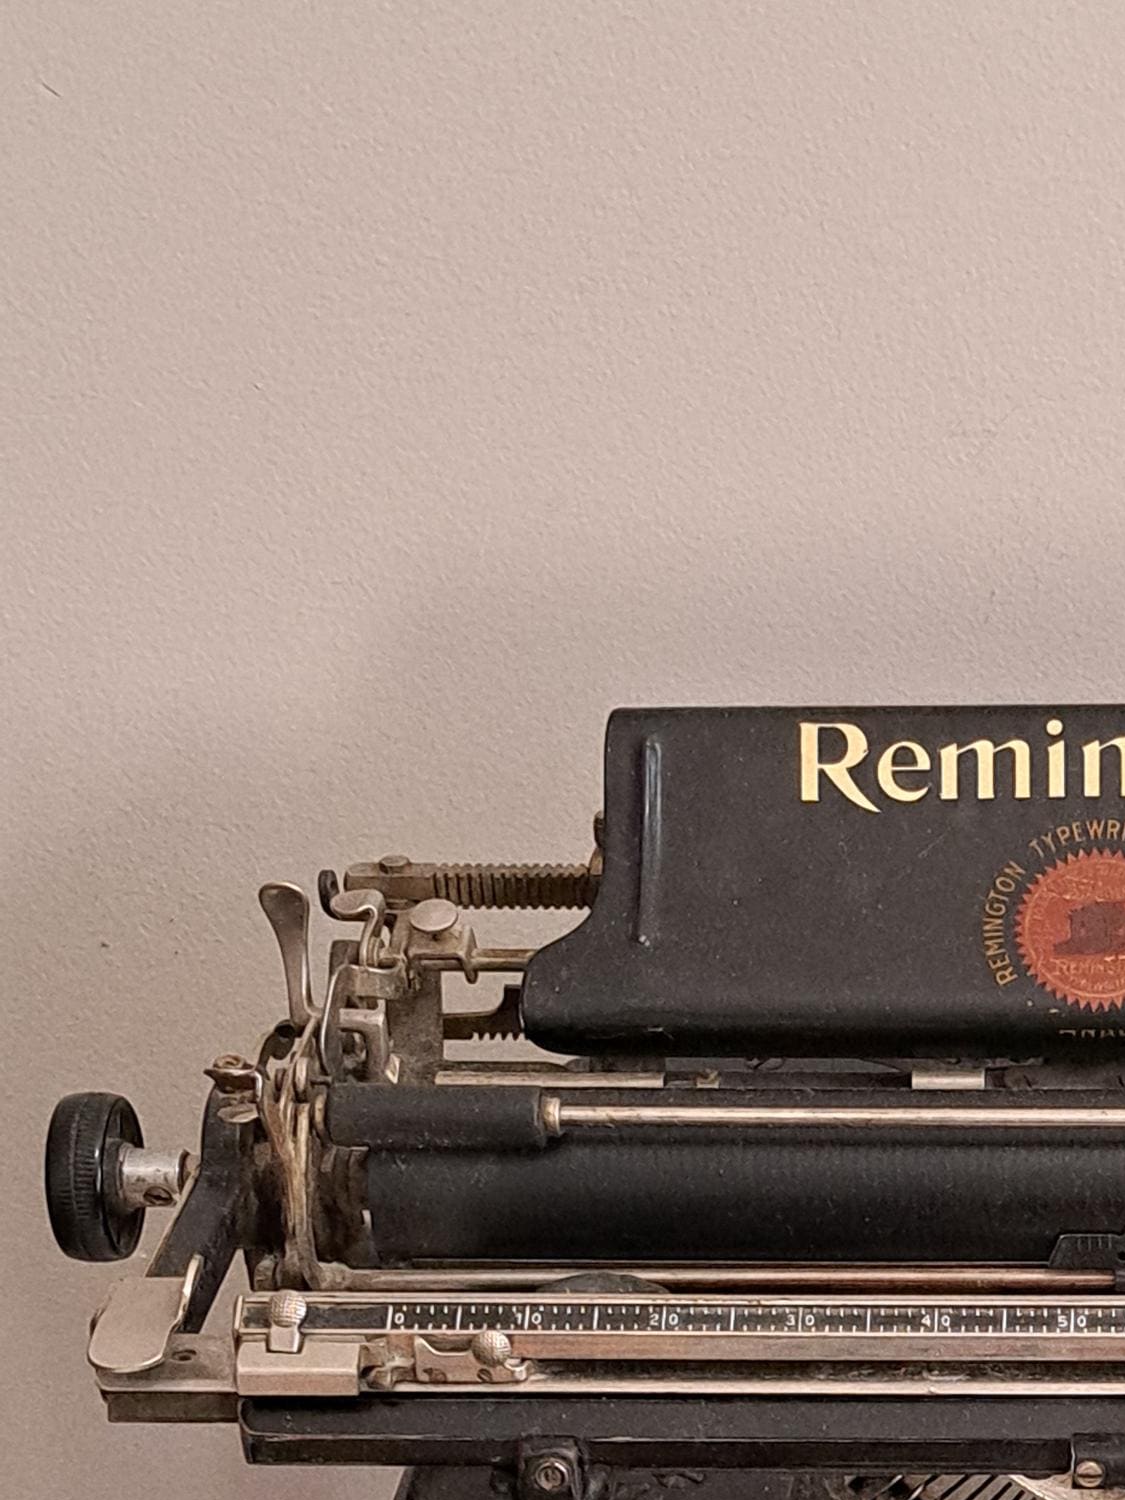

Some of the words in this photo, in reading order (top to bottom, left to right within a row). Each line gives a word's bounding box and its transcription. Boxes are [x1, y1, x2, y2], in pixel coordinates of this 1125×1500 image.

[982, 861, 1026, 987] REMINGTON
[394, 1312, 404, 1326] 0
[515, 1312, 542, 1326] 10
[650, 1312, 680, 1327] 20
[785, 1313, 816, 1327] 30
[921, 1313, 950, 1328] 40
[1057, 1314, 1088, 1328] 50
